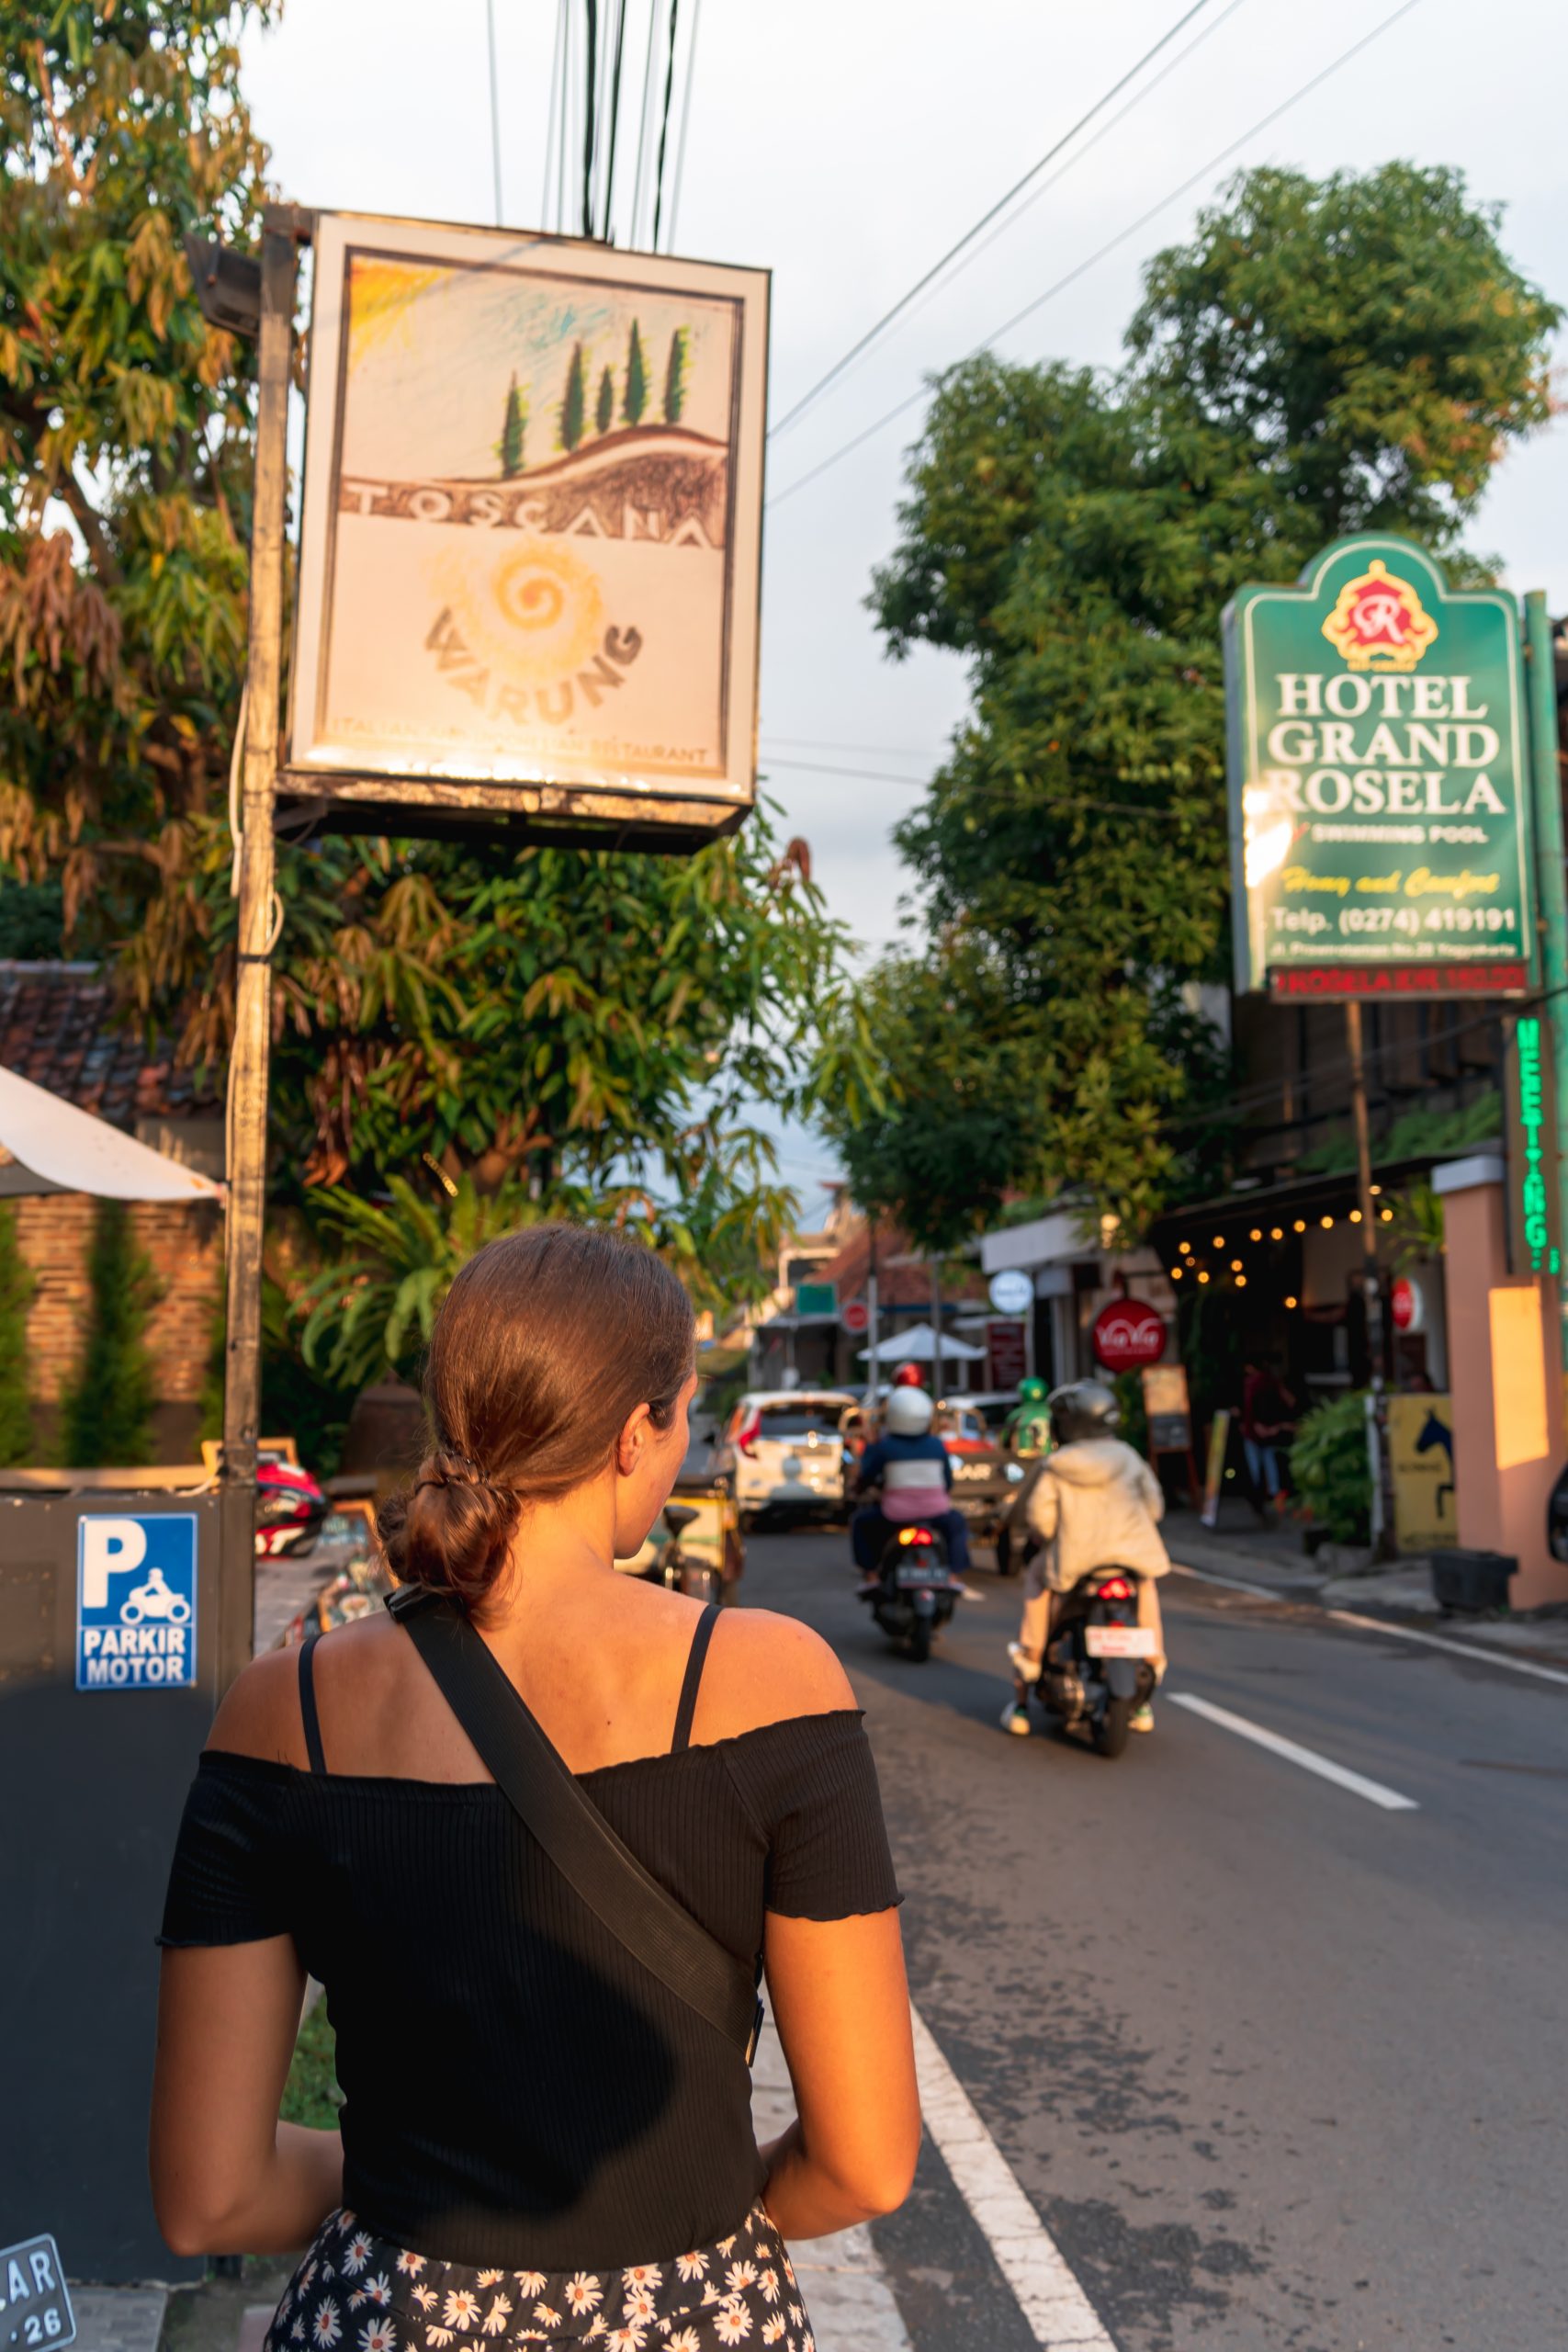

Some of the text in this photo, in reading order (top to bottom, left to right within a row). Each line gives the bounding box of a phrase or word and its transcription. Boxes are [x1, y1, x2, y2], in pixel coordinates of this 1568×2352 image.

[344, 482, 715, 550] TOSCANA
[424, 605, 644, 727] WARUNG
[1276, 673, 1489, 720] HOTEL
[1267, 720, 1501, 768] GRAND
[1265, 768, 1508, 815] ROSELA
[1429, 824, 1489, 843] POOL
[1338, 907, 1420, 937] (0274)
[1424, 907, 1516, 932] 419191
[84, 1519, 147, 1609] P
[84, 1627, 186, 1657] PARKIR
[86, 1656, 184, 1684] MOTOR
